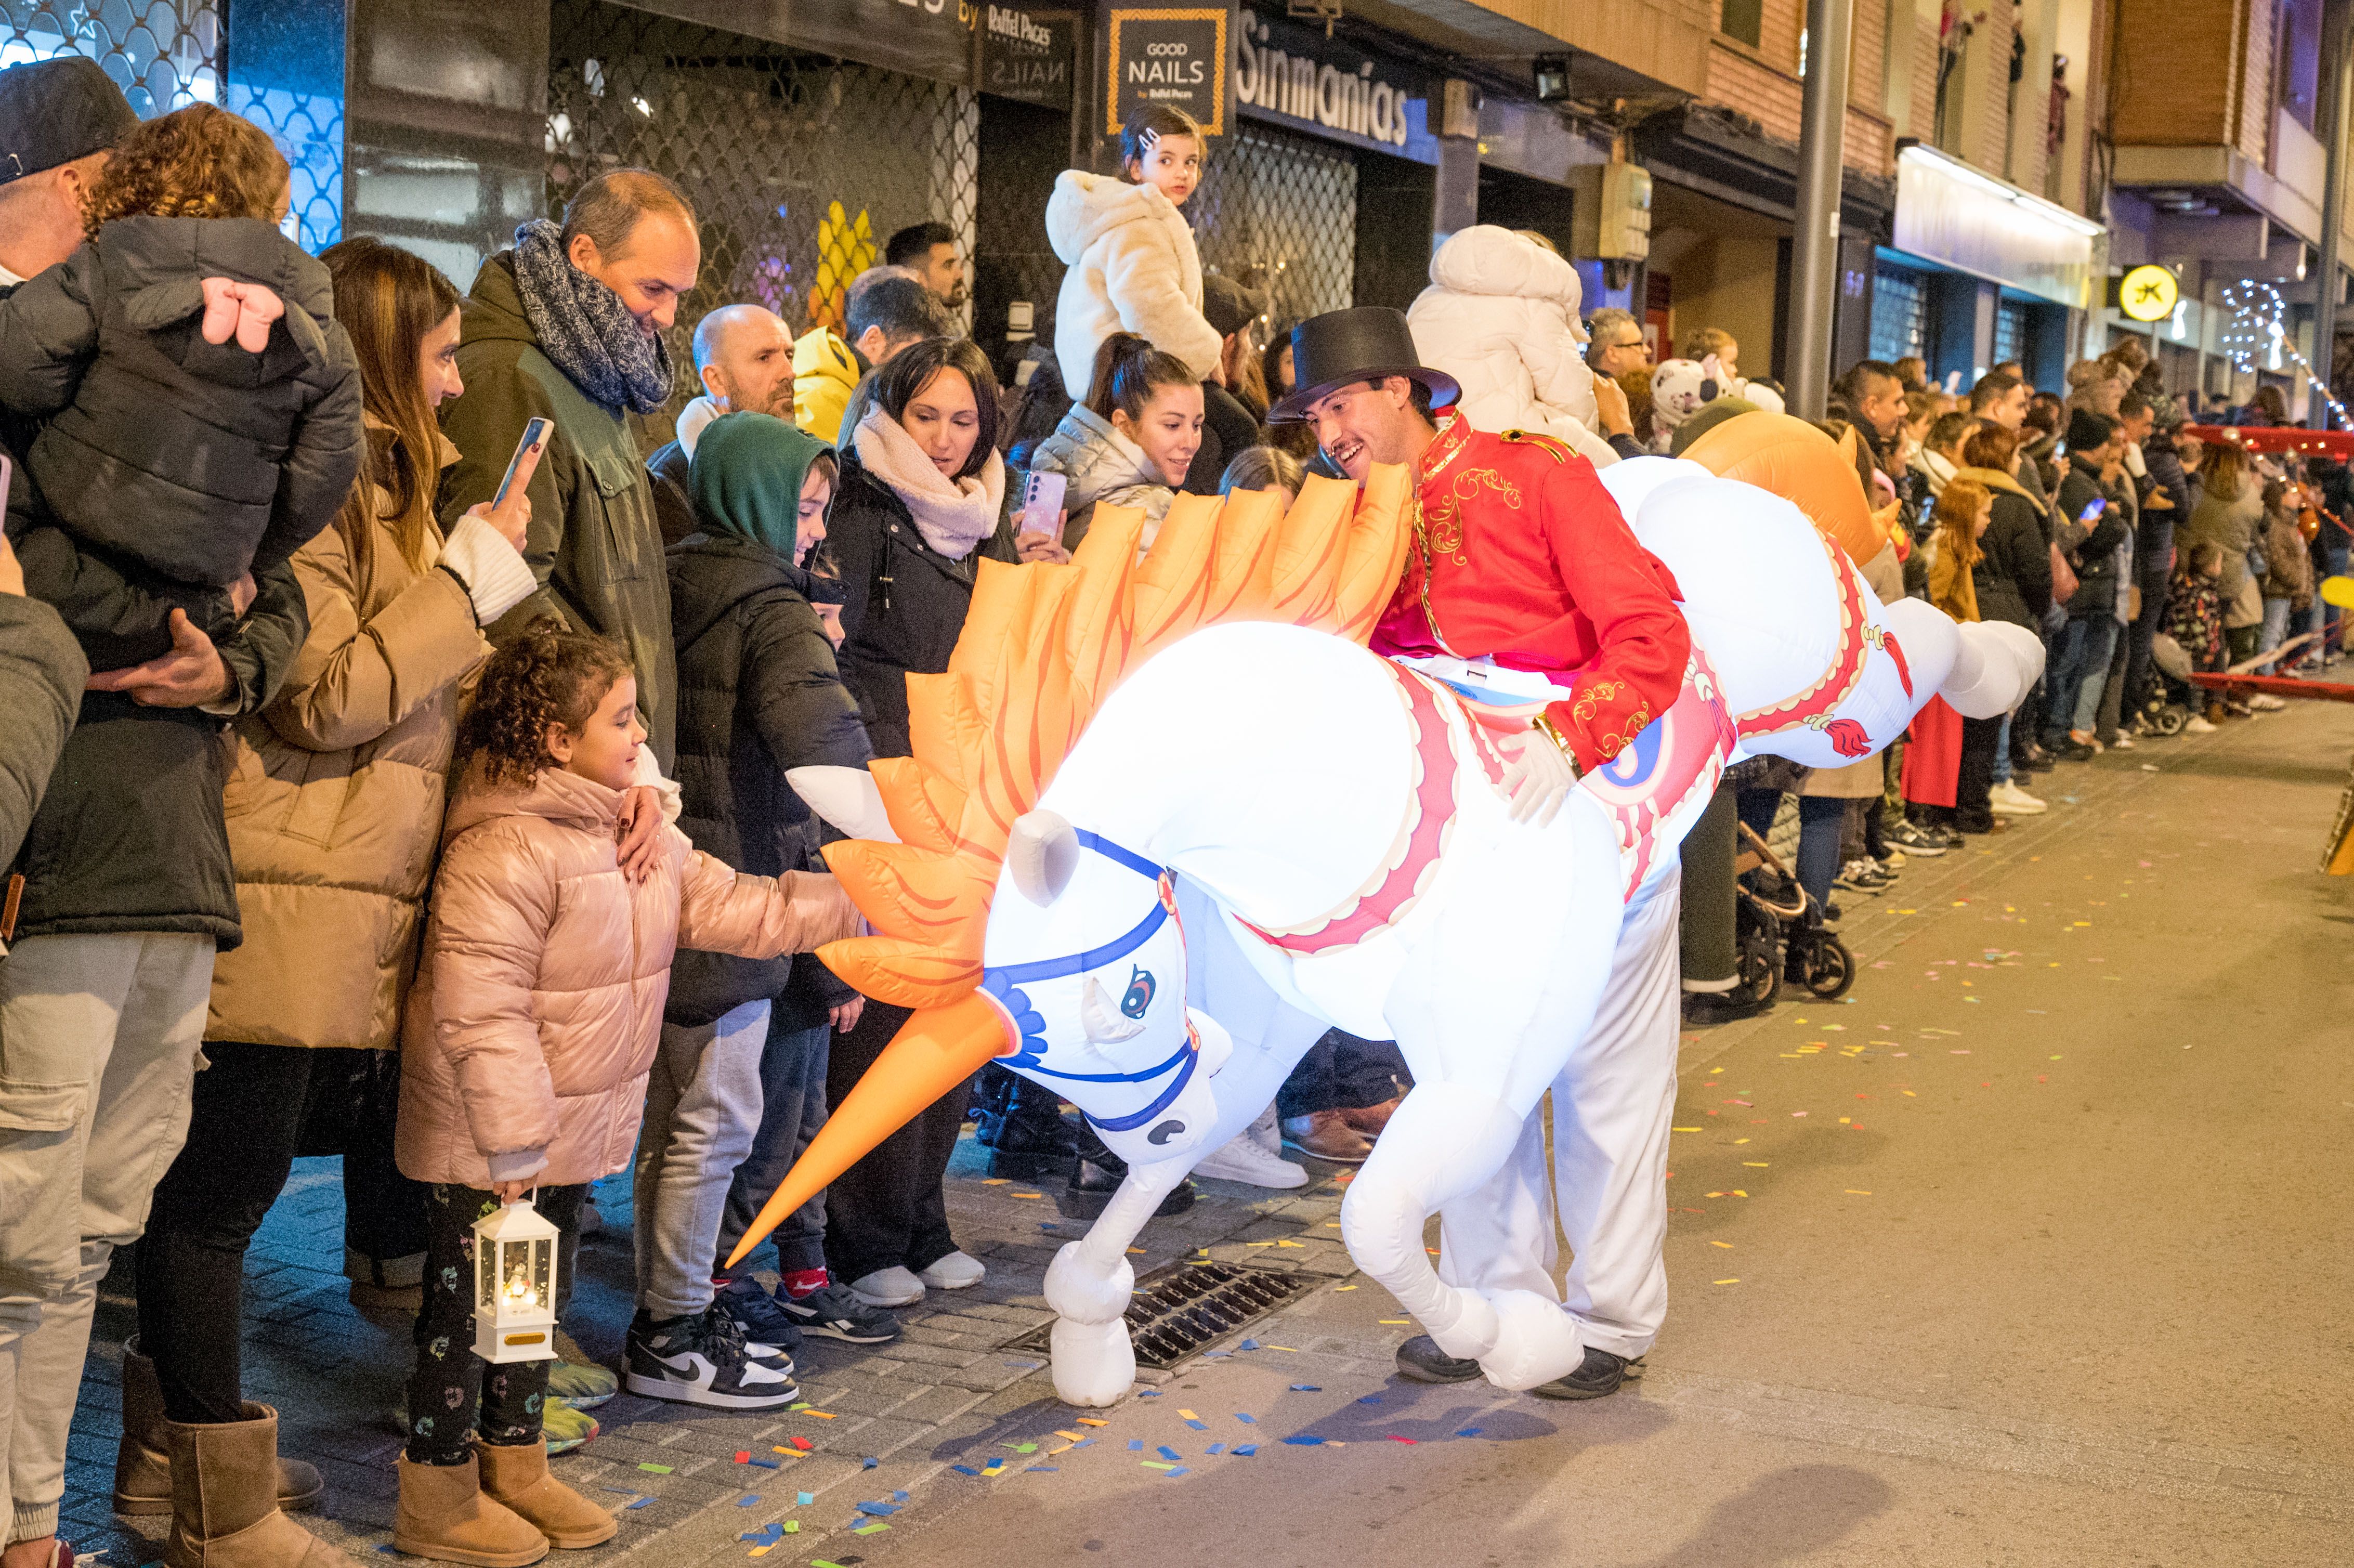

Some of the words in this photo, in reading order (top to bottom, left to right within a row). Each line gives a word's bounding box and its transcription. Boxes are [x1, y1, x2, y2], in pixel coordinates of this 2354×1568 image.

[958, 0, 978, 31] by
[1147, 43, 1188, 57] GOOD
[1128, 60, 1204, 83] NAILS
